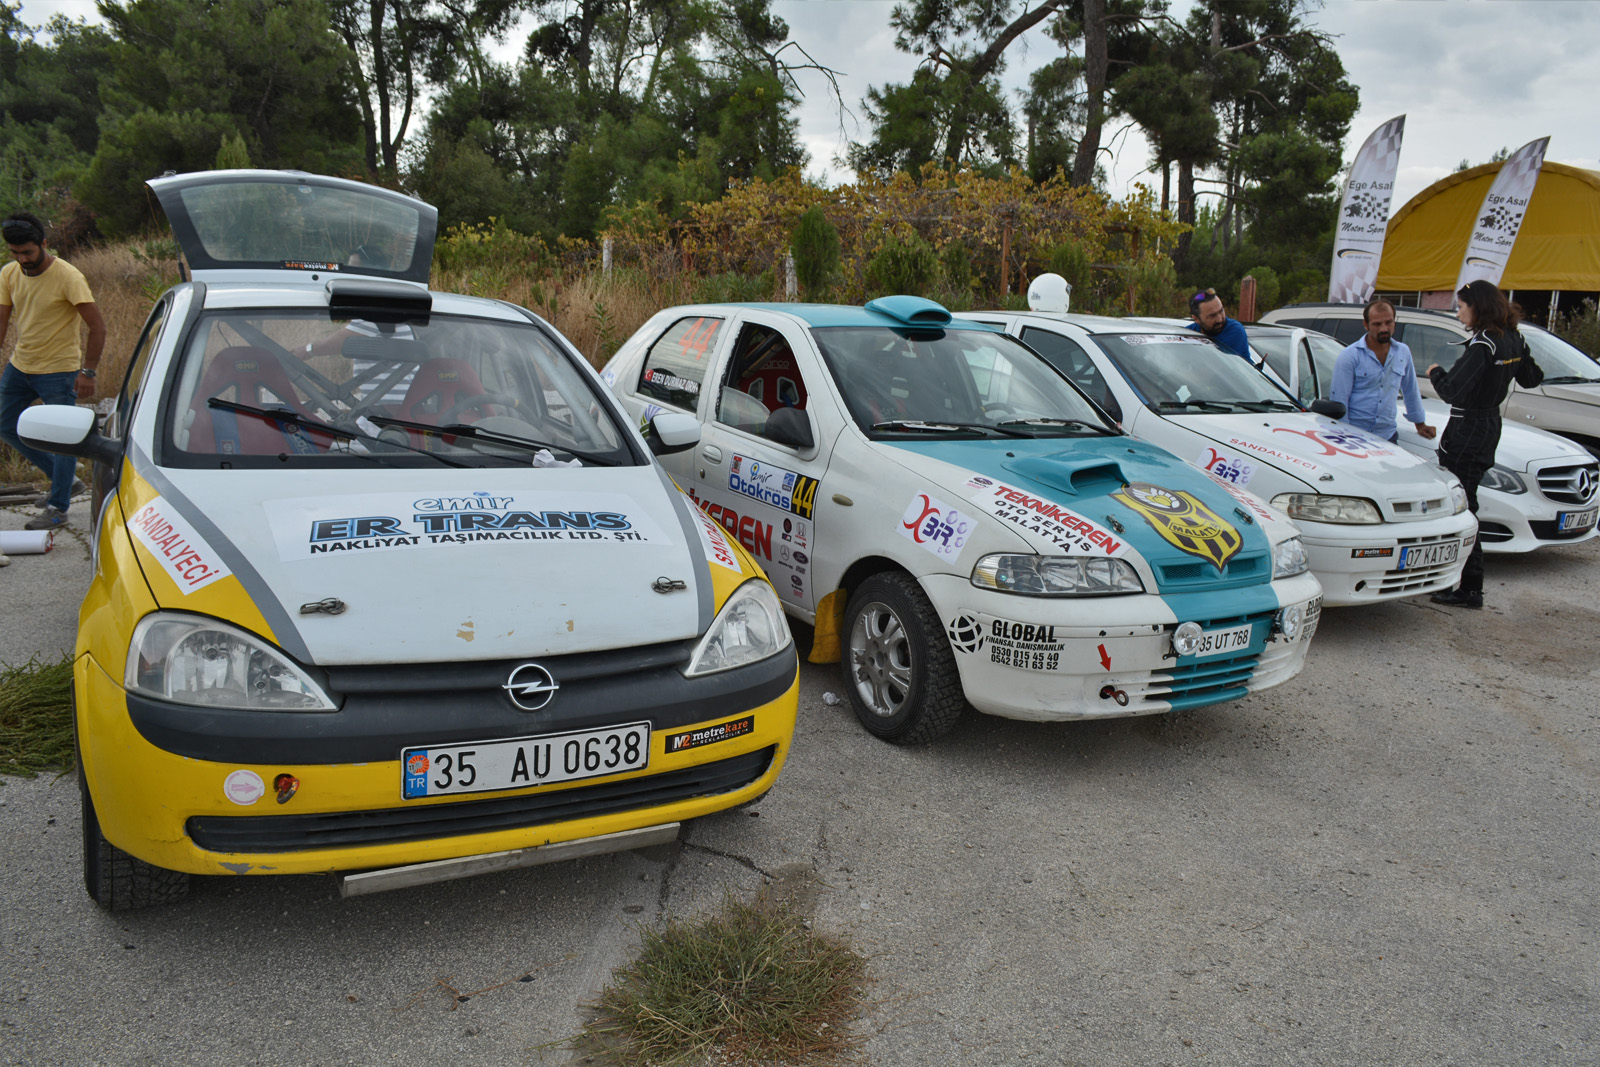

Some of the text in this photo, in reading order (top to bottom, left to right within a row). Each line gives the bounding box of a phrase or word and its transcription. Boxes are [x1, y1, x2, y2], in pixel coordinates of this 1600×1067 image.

[1349, 180, 1393, 191] Ege Asal
[1488, 193, 1528, 206] Ege Asal
[1341, 221, 1384, 235] Motor Spor
[1474, 231, 1512, 247] Motor Spor
[678, 317, 720, 360] 44
[412, 491, 514, 511] emir
[729, 474, 818, 518] Otokros 44
[994, 500, 1028, 516] OTO
[310, 511, 632, 543] ER TRANS
[1565, 514, 1575, 528] 07
[428, 531, 563, 545] TAŞIMACILIK
[568, 530, 609, 540] LTD.
[994, 509, 1071, 553] MALATYA
[1406, 549, 1422, 567] 07
[1423, 546, 1444, 564] KAT
[992, 620, 1058, 643] GLOBAL
[1199, 629, 1249, 652] 35 UT 768
[991, 646, 1060, 662] 0530 015 45 40
[991, 654, 1058, 670] 0542 621 63 52
[692, 720, 749, 741] metrekare
[434, 731, 641, 789] 35 AU 0638
[408, 778, 425, 788] TR
